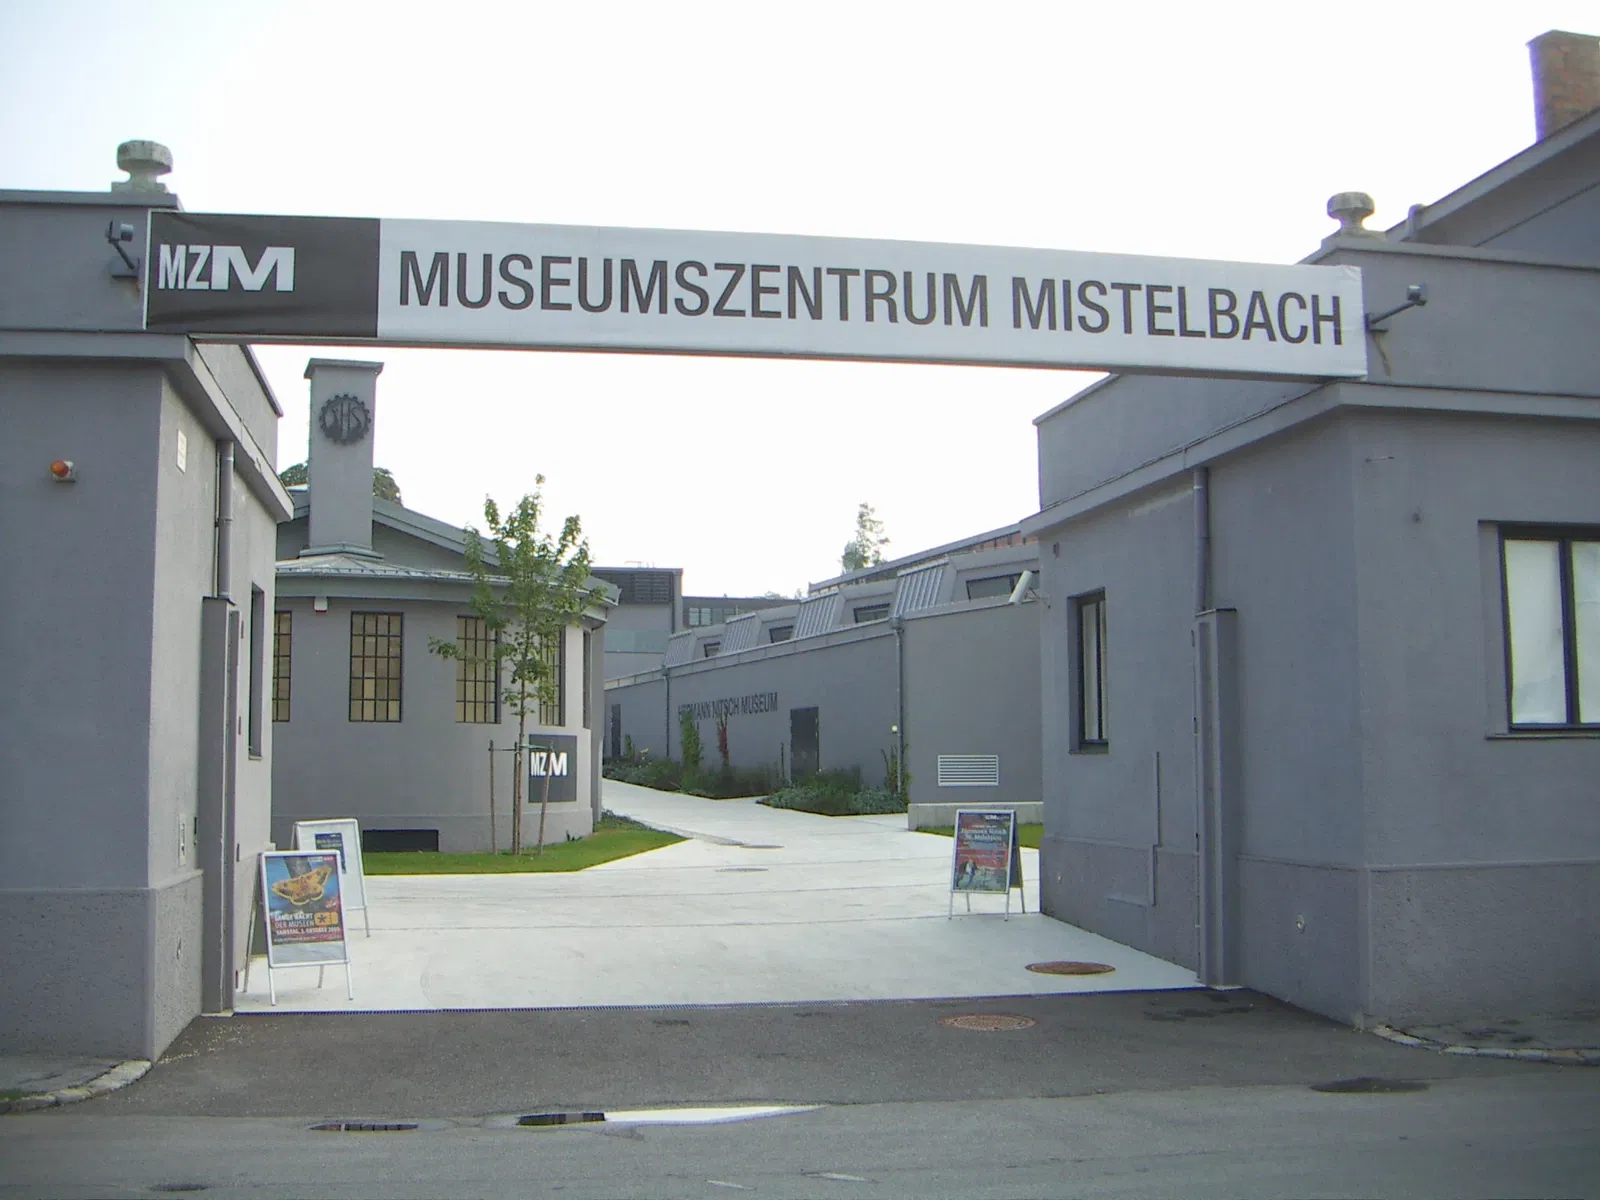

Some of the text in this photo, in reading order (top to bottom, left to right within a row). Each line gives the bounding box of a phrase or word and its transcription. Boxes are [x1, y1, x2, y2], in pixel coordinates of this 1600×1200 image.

[158, 244, 295, 291] MZM
[399, 250, 1343, 346] MUSEUMSZENTRUM MISTELBACH
[712, 697, 740, 719] NITSCH
[741, 692, 778, 715] MUSEUM
[530, 751, 568, 777] MZM
